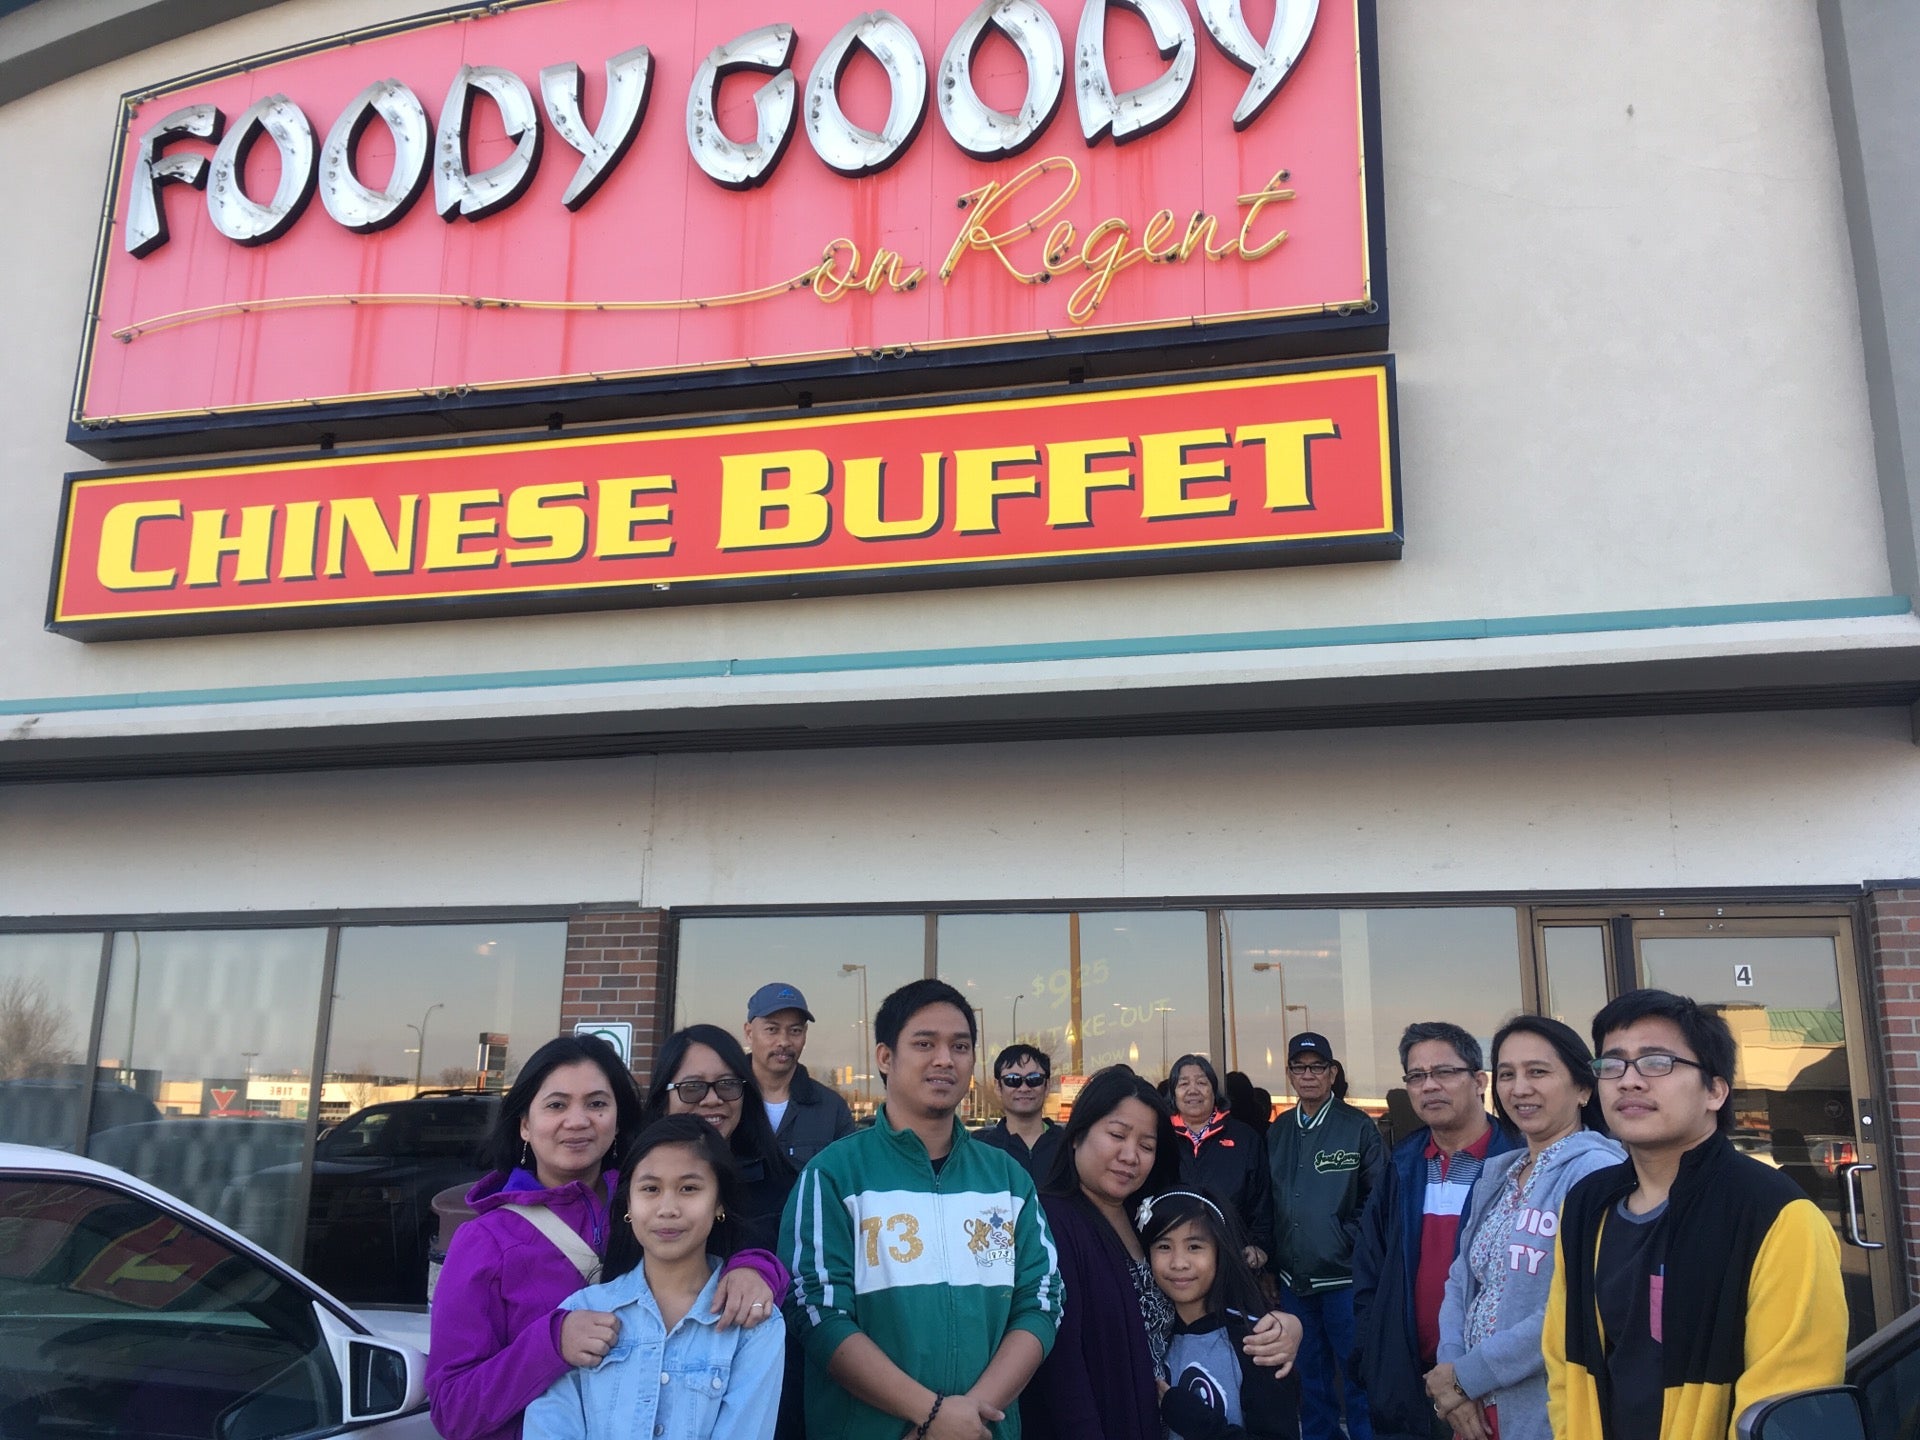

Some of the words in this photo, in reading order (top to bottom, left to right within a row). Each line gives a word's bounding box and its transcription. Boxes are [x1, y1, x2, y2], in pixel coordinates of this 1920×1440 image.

[125, 44, 656, 259] FOODY
[686, 0, 1320, 190] GOODY
[806, 237, 927, 303] on
[939, 156, 1296, 324] Regent
[97, 474, 678, 591] CHINESE
[716, 417, 1342, 553] BUFFET
[1737, 966, 1752, 985] 4
[860, 1212, 924, 1267] 73
